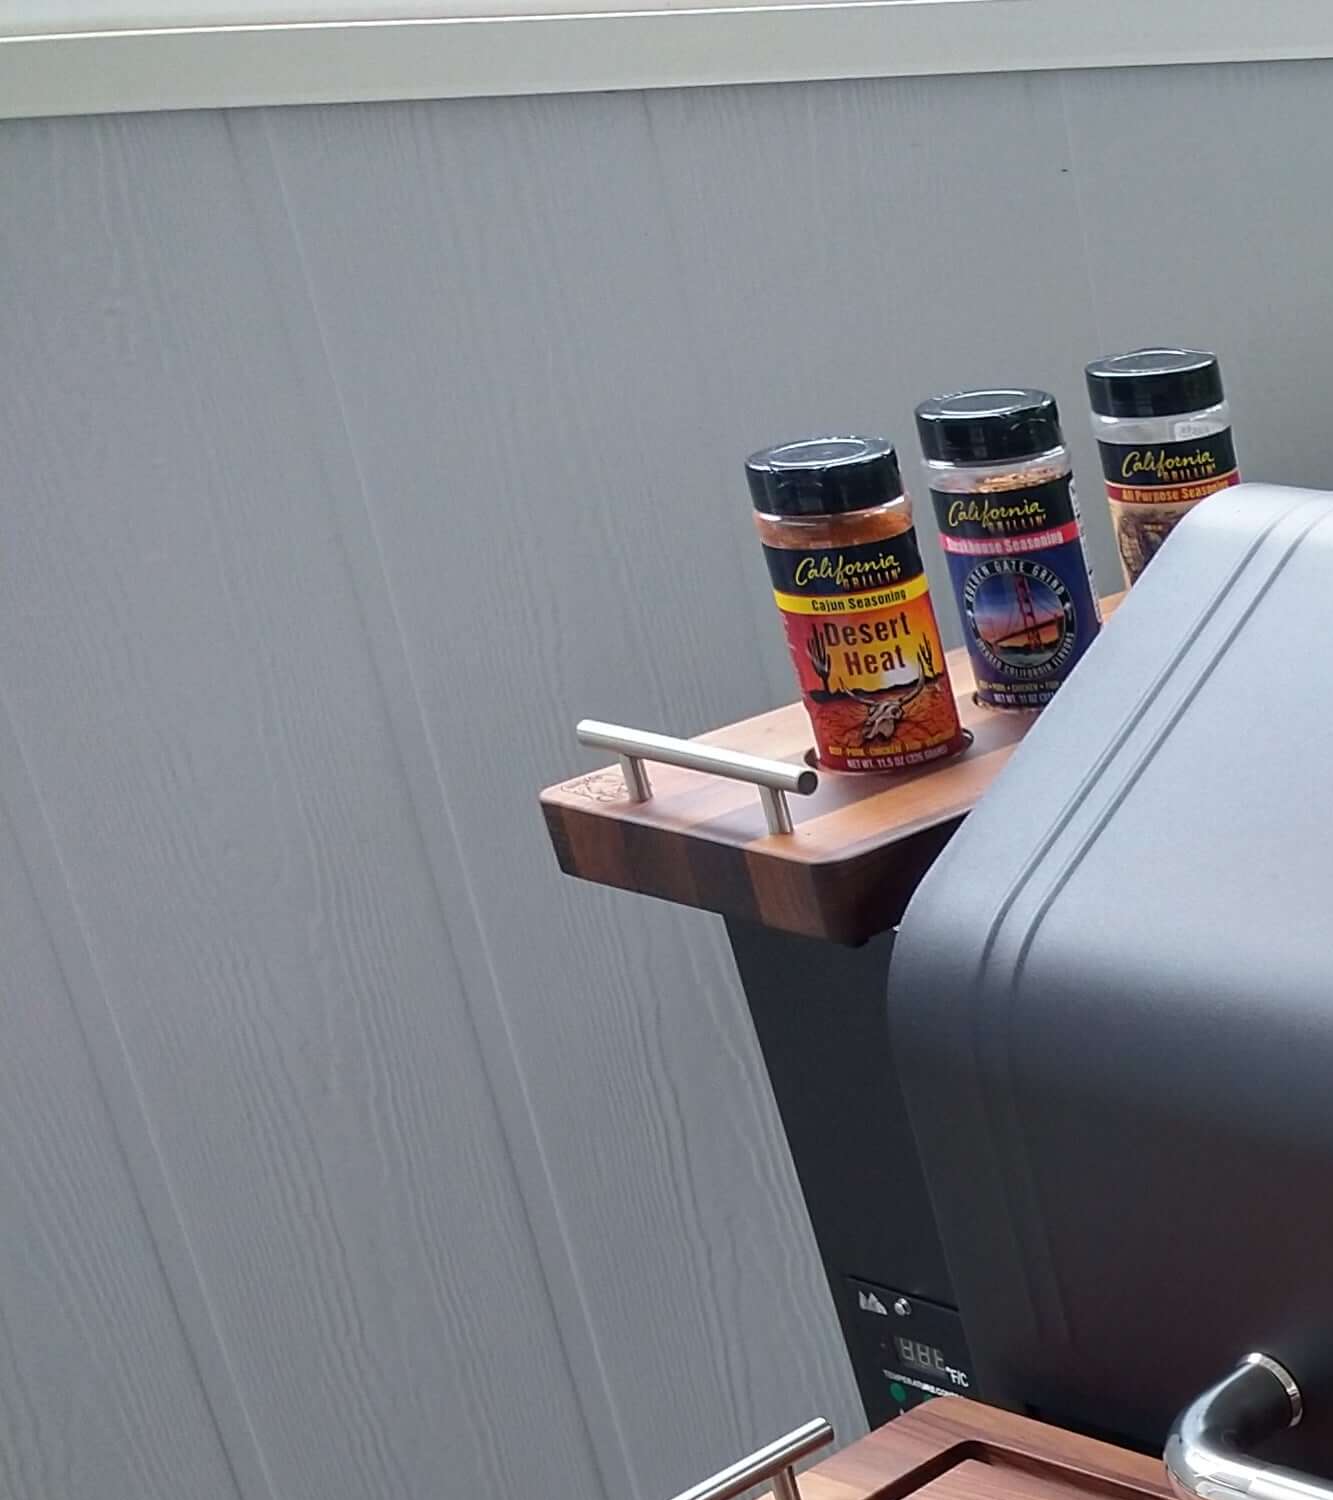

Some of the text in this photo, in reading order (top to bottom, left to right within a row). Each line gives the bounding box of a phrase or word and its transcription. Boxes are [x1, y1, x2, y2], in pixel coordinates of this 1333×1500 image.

[1121, 449, 1215, 478] California
[1134, 490, 1180, 501] Purpose
[948, 499, 1046, 529] California
[1005, 531, 1064, 552] Seasoning
[795, 553, 900, 587] California
[993, 560, 1025, 575] GATE
[811, 588, 907, 613] Cajun Seasoning
[823, 611, 911, 647] Desert
[843, 645, 906, 677] Heat
